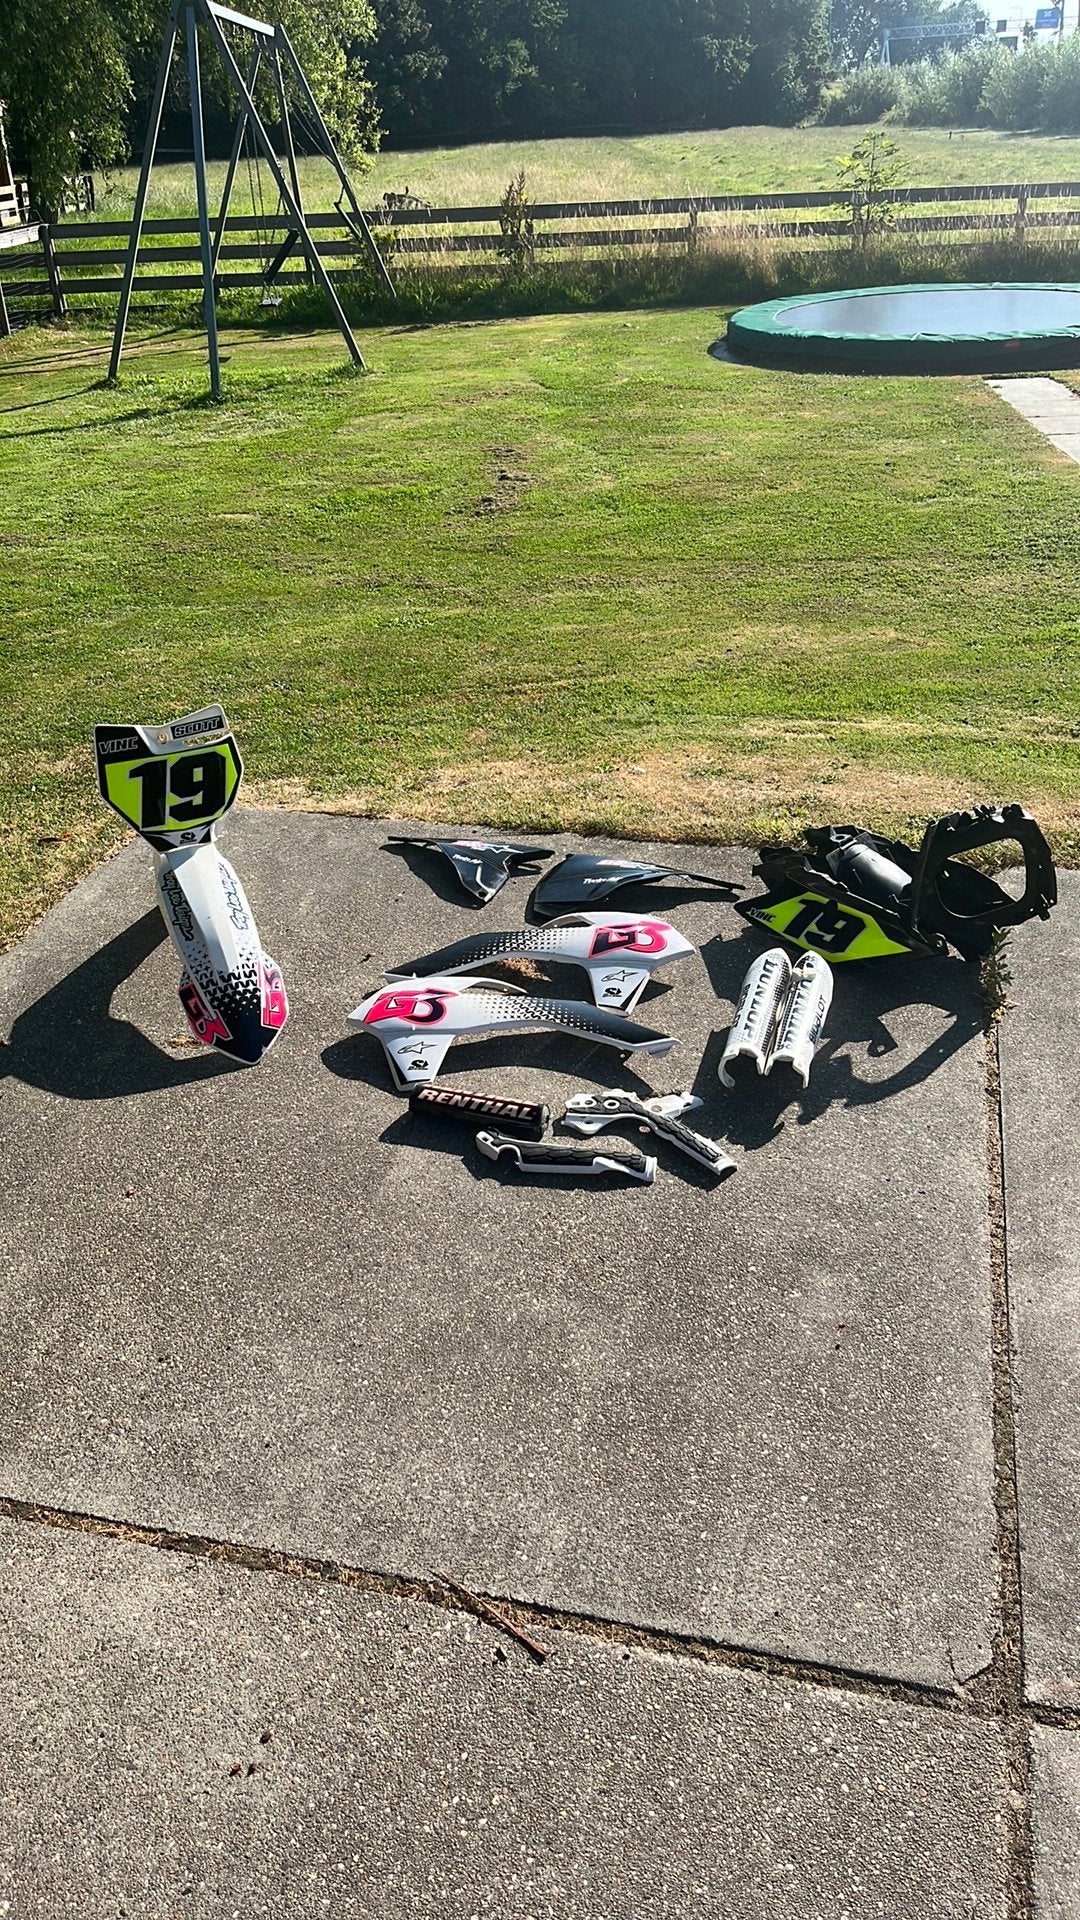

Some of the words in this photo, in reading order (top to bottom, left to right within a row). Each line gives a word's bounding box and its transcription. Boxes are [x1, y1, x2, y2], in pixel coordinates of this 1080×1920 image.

[174, 717, 220, 737] SCOTT
[98, 736, 139, 754] VINC
[128, 751, 227, 829] 19
[749, 907, 777, 924] VINC
[781, 898, 869, 954] 19
[417, 1088, 535, 1120] RENTHAL
